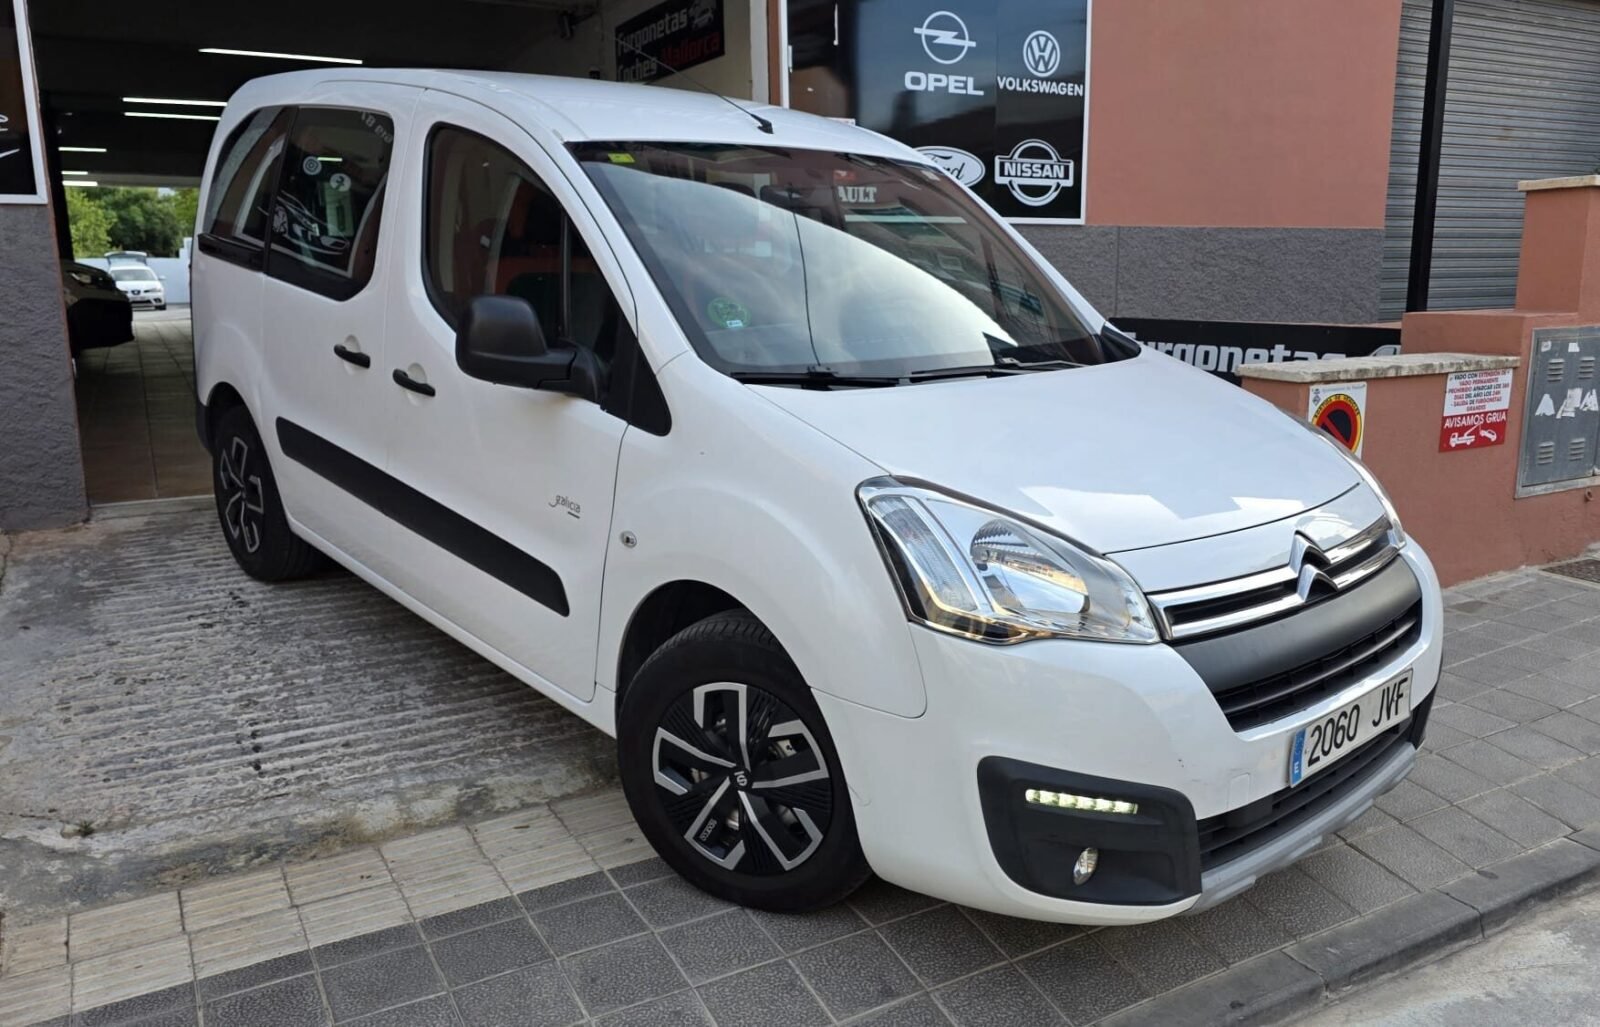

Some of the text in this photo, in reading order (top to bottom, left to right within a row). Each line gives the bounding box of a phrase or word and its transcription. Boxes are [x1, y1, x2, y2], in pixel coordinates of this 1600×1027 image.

[617, 8, 688, 56] Furgonetas
[904, 71, 985, 96] OPEL
[996, 76, 1084, 97] VOLKSWAGEN
[1003, 161, 1066, 178] NISSAN
[1443, 411, 1507, 429] AVISAMOS GRUA
[1307, 677, 1408, 767] 2060 JVF
